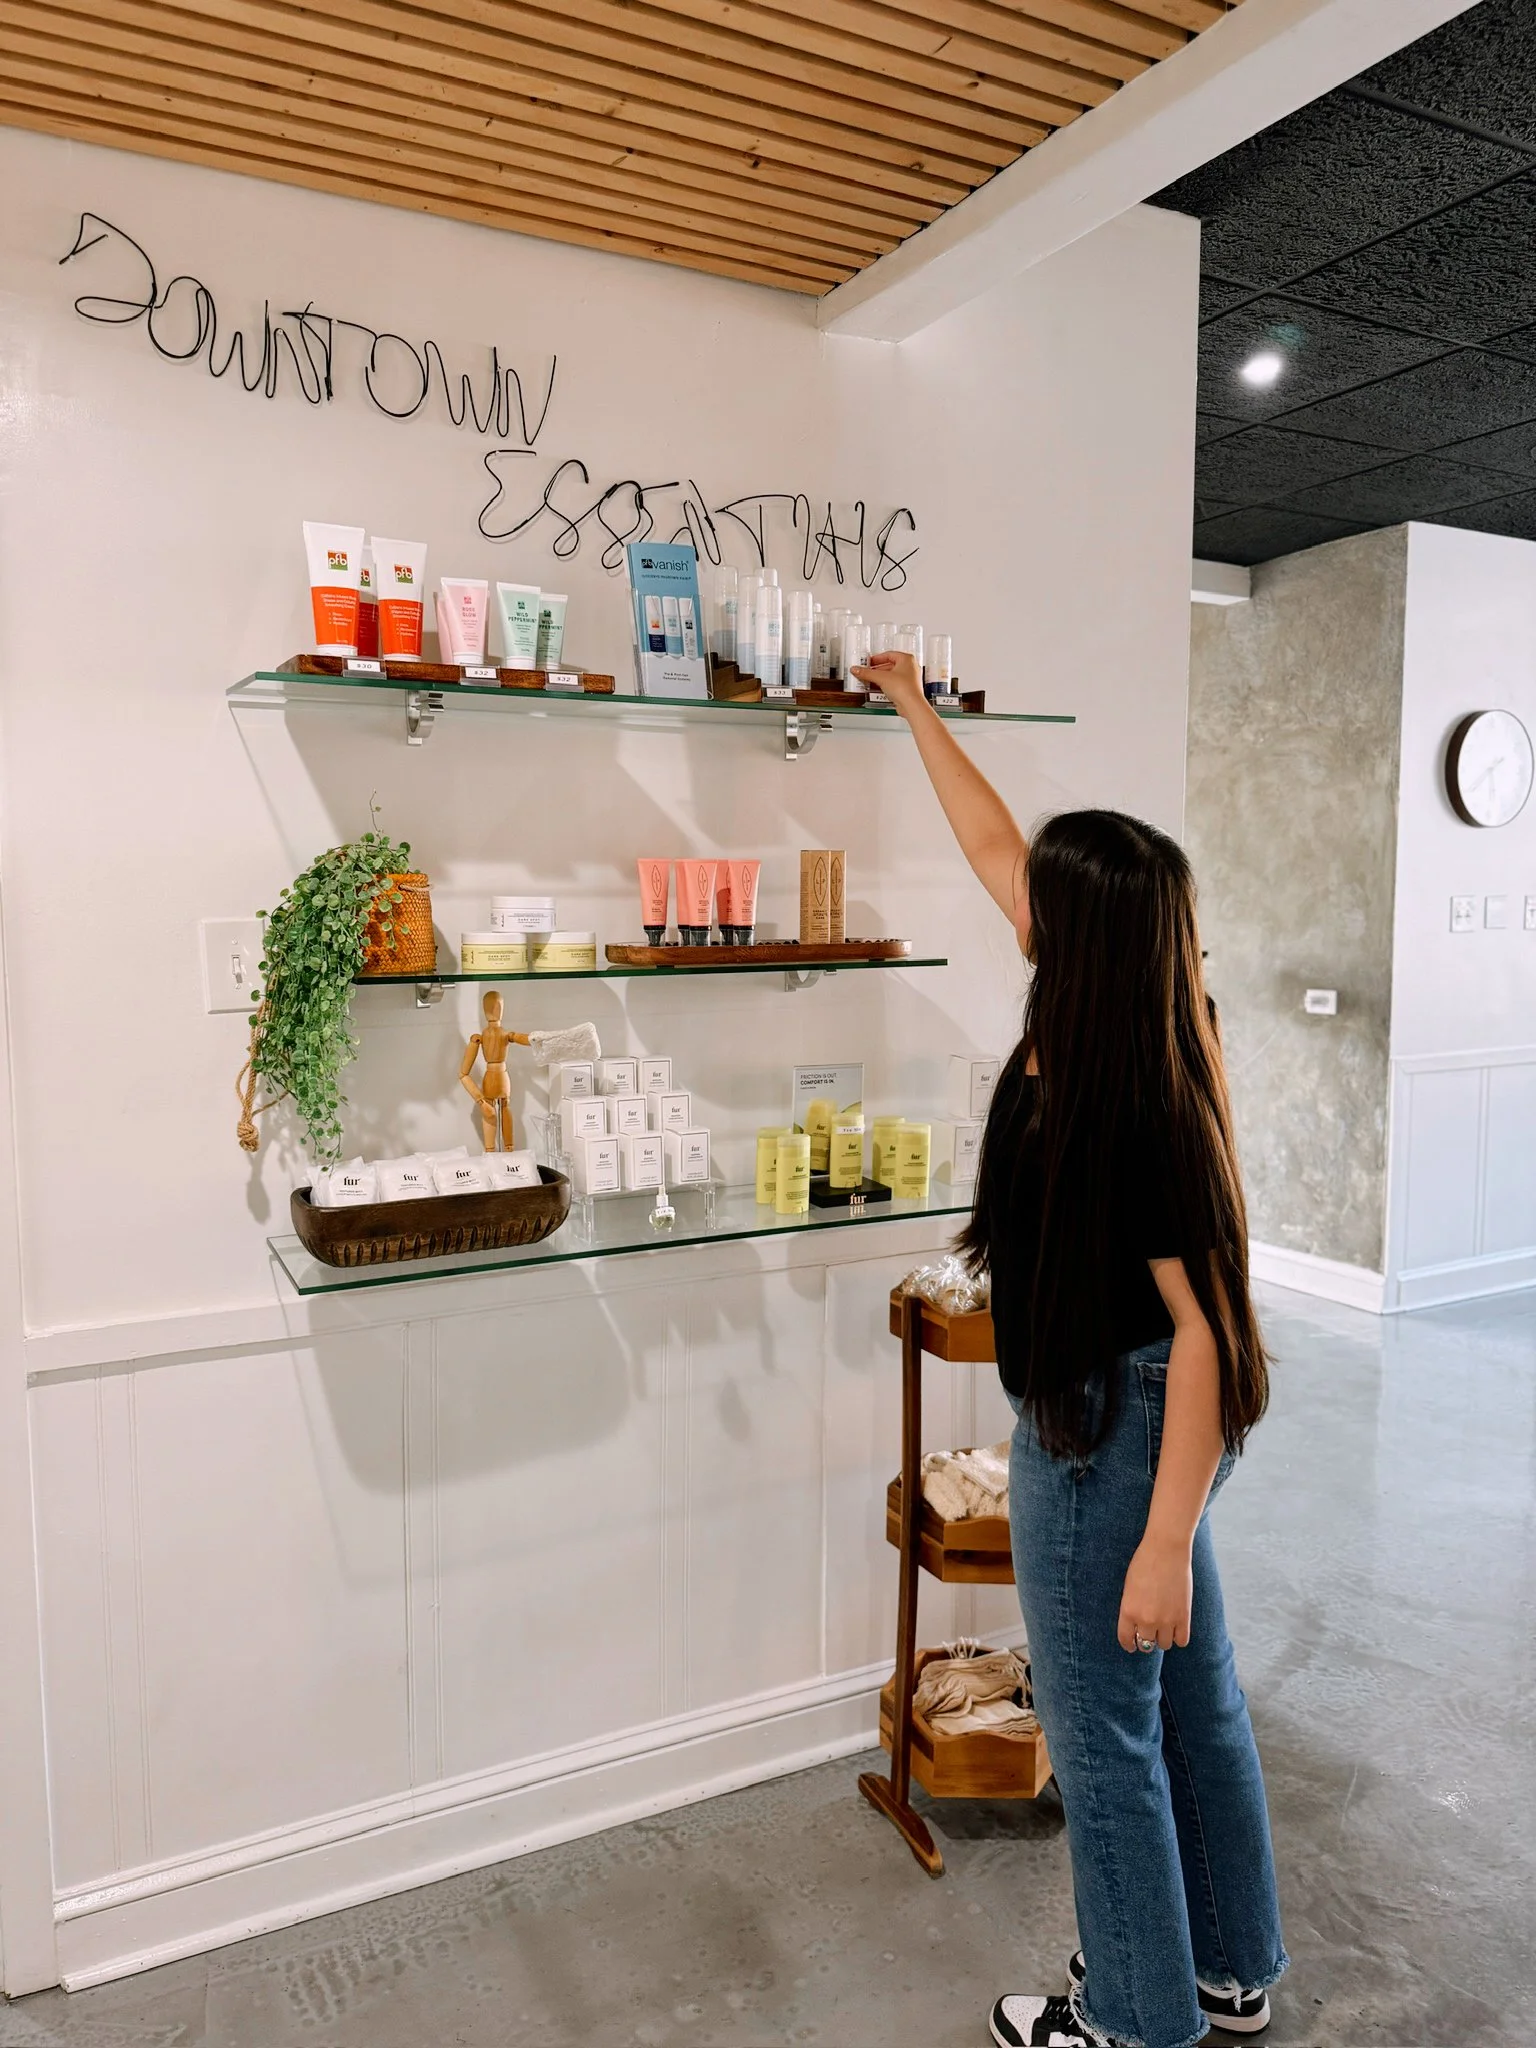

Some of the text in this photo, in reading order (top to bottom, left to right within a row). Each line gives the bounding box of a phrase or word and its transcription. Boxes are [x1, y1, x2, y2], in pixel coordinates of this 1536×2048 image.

[59, 212, 557, 445] DOWNTOWN
[328, 551, 348, 570] pfb
[653, 560, 689, 572] vanish
[394, 565, 413, 583] pfb
[343, 1176, 361, 1186] fur
[849, 1192, 867, 1204] fur
